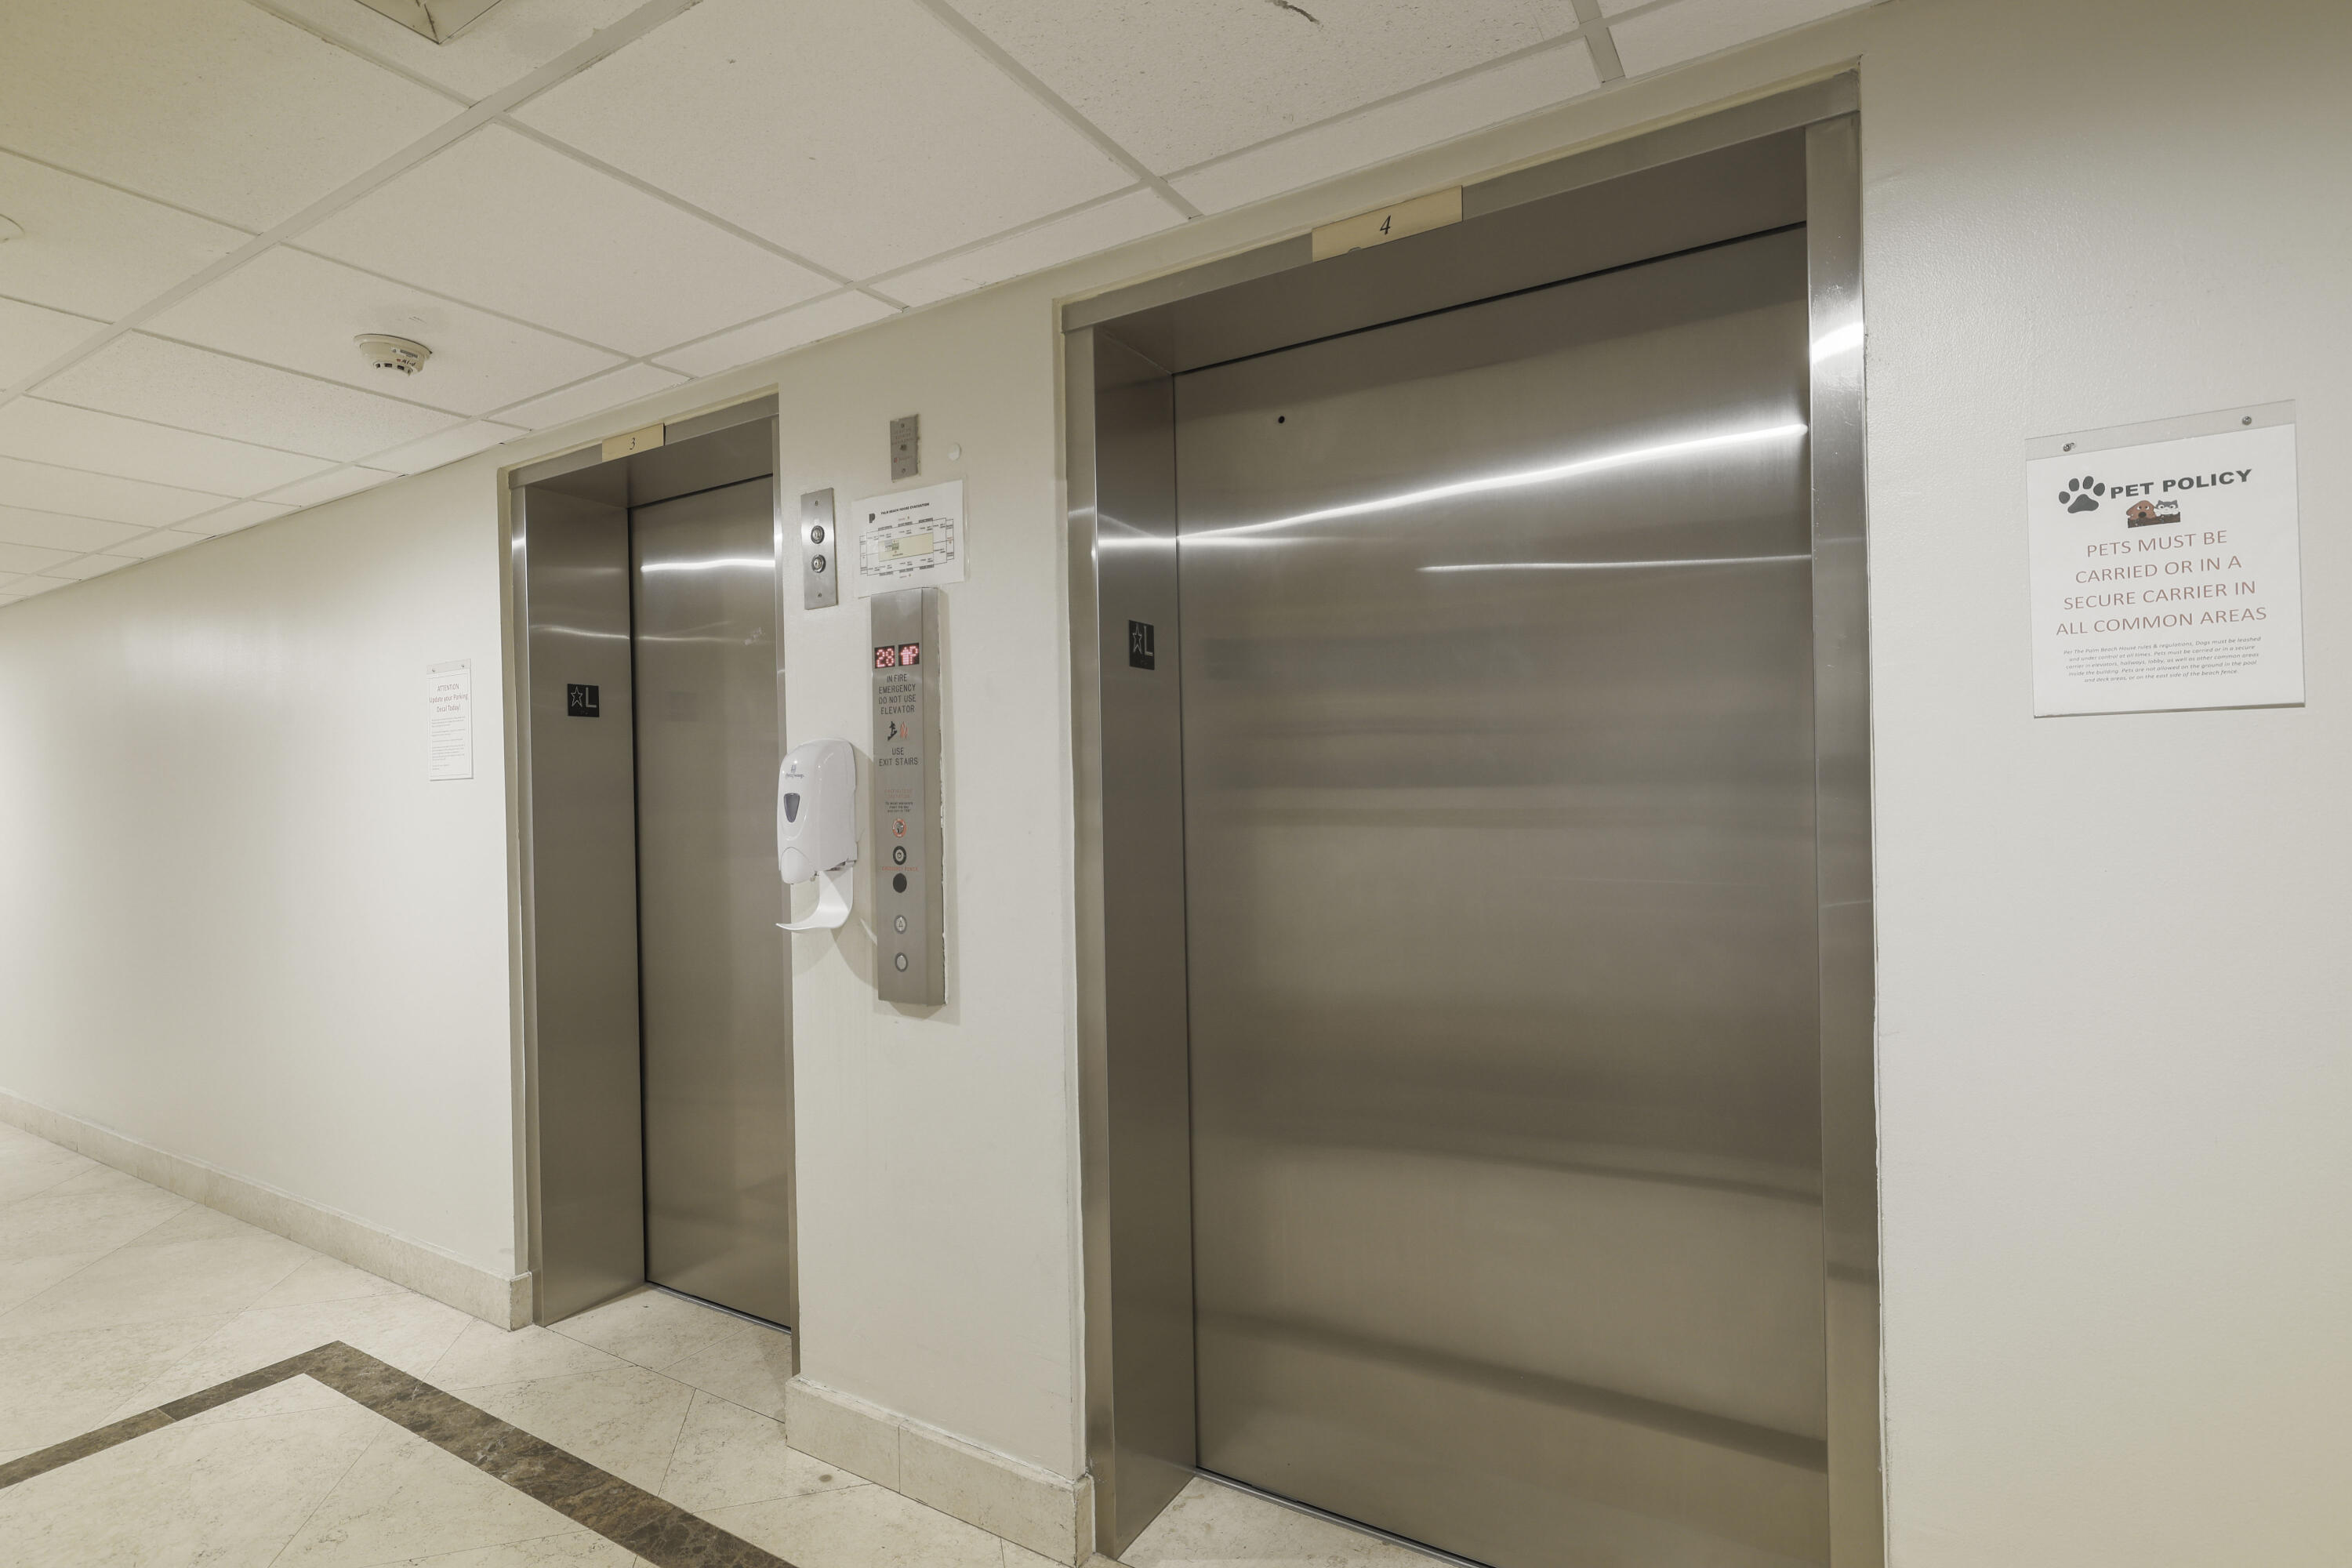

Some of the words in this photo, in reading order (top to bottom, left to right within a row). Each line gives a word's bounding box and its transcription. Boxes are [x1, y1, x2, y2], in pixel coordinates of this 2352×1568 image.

[1380, 215, 1391, 234] 4
[630, 437, 635, 450] 3
[2111, 481, 2154, 499] PET
[2162, 469, 2252, 492] POLICY
[2087, 540, 2132, 557] PETS
[2138, 533, 2197, 552] MUST
[2204, 530, 2227, 545] BE
[2075, 564, 2158, 583] CARRIED
[2165, 560, 2193, 575] OR
[2201, 557, 2220, 572] IN
[2227, 555, 2242, 569] A
[2063, 592, 2136, 610] SECURE
[2143, 583, 2227, 604] CARRIER
[2235, 580, 2256, 595] IN
[2056, 621, 2088, 635] ALL
[2094, 612, 2193, 633] COMMON
[2200, 606, 2267, 625] AREAS
[877, 648, 895, 667] 28
[879, 684, 916, 694] EMERGENCY
[904, 694, 916, 702] USE
[881, 706, 915, 715] ELEVATOR
[895, 757, 918, 766] STAIRS
